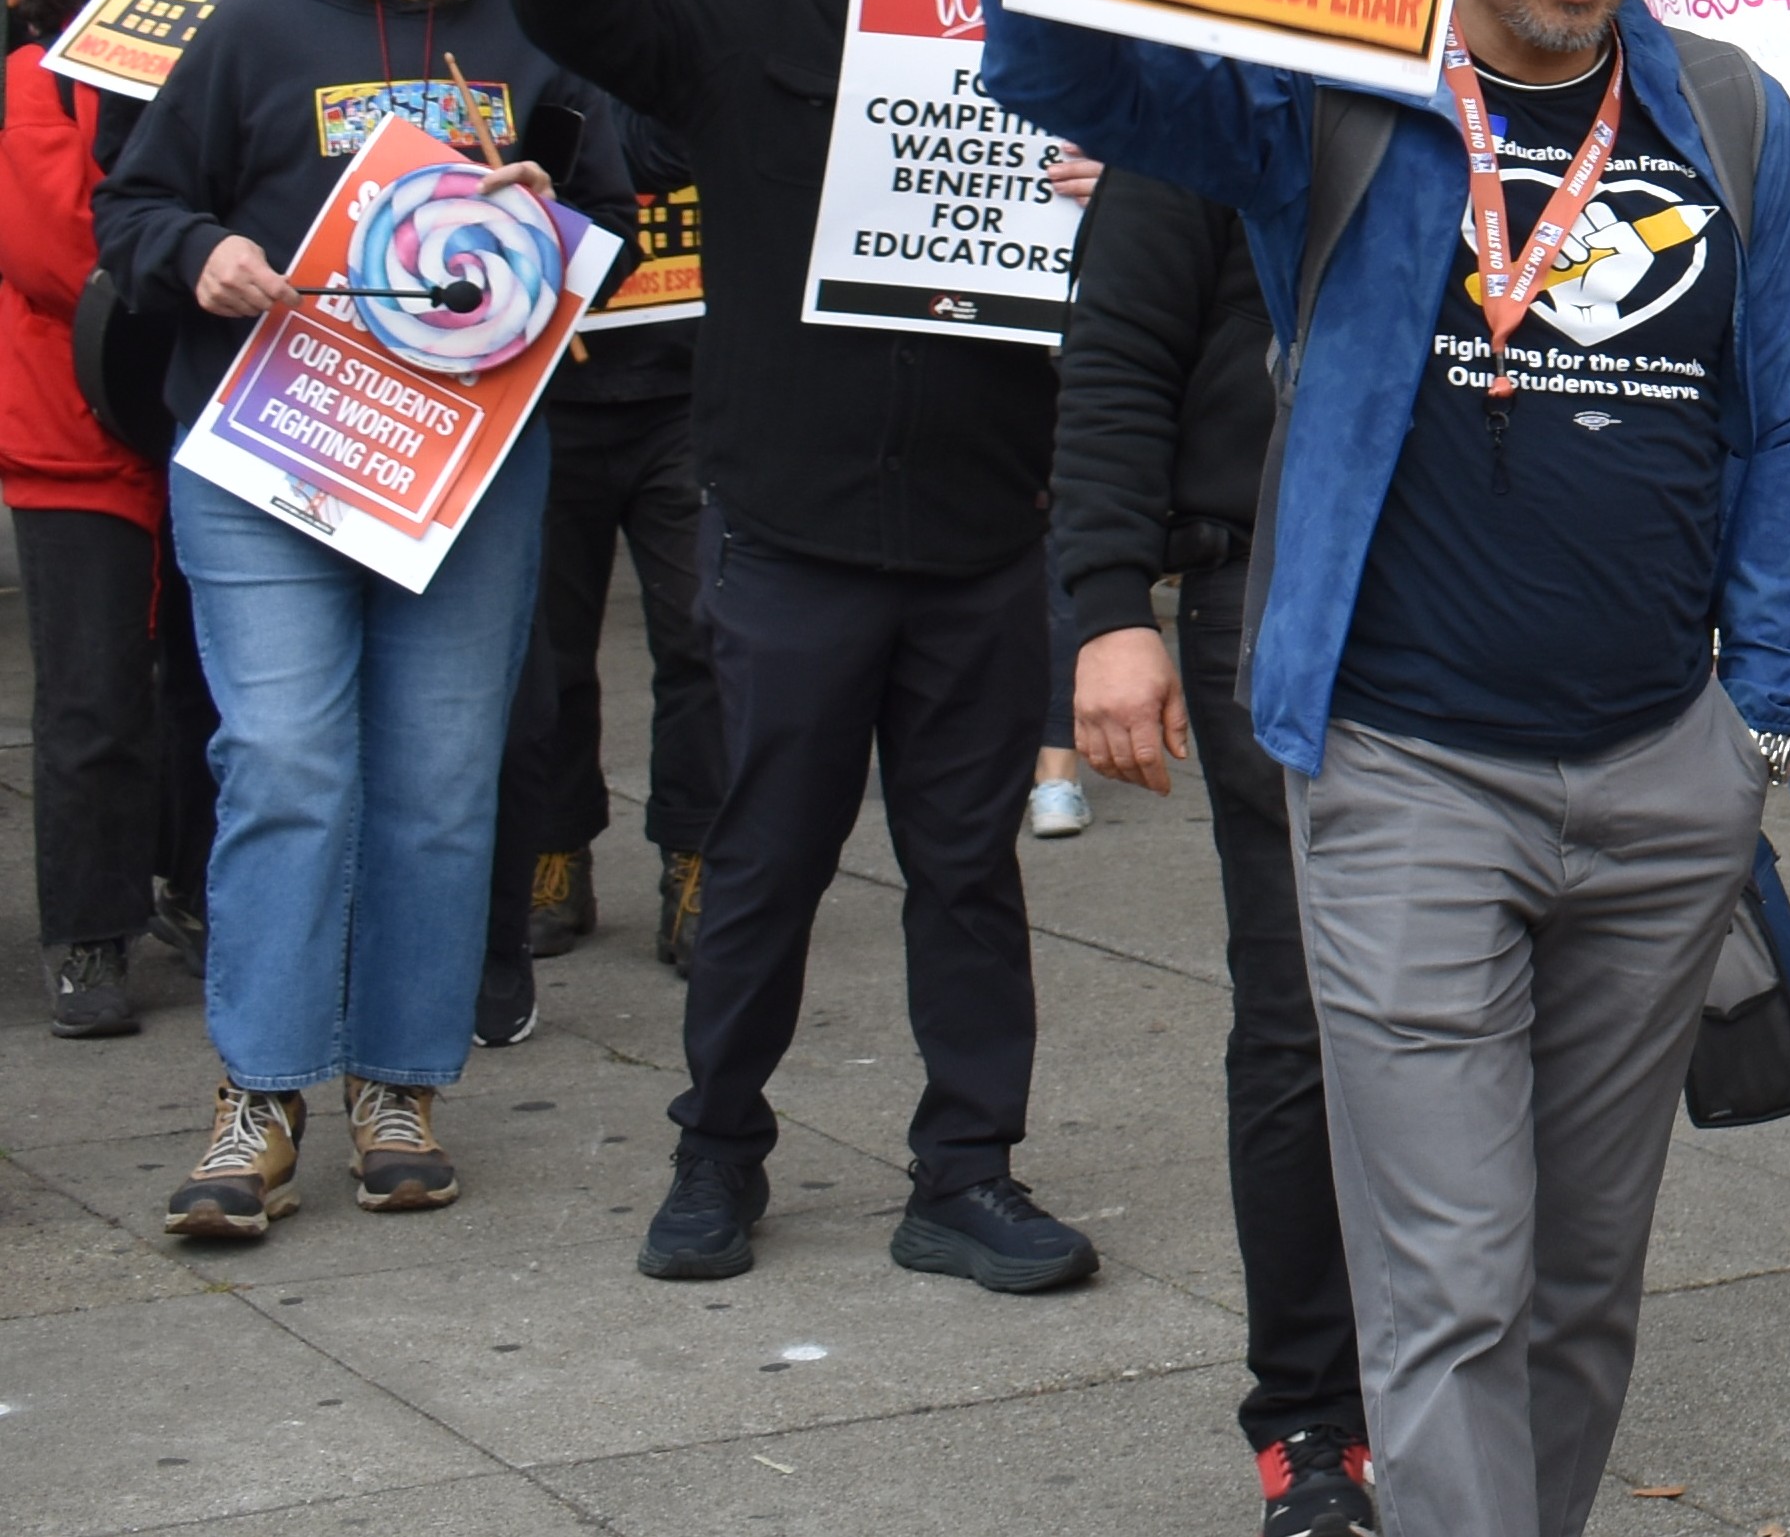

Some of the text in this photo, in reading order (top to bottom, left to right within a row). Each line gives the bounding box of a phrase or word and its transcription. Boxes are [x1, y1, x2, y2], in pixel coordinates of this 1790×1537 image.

[75, 34, 108, 63] NO
[1462, 97, 1483, 132] STRIKE
[891, 132, 1063, 171] WAGES &
[1567, 144, 1602, 197] ON STRIKE
[892, 167, 1054, 205] BENEFITS
[931, 203, 1004, 234] FOR
[853, 230, 1074, 274] EDUCATORS
[1484, 210, 1504, 270] ON STRIKE
[1510, 245, 1547, 302] ON STRIKE
[1434, 334, 1542, 369] Fighing
[1547, 348, 1584, 371] for
[1589, 352, 1631, 373] the
[287, 332, 460, 436] OUR STUDENTS
[1507, 369, 1619, 395] Students
[1620, 379, 1700, 401] Deserve
[285, 373, 424, 458] ARE WORTH
[258, 397, 416, 495] FIGHTING FOR
